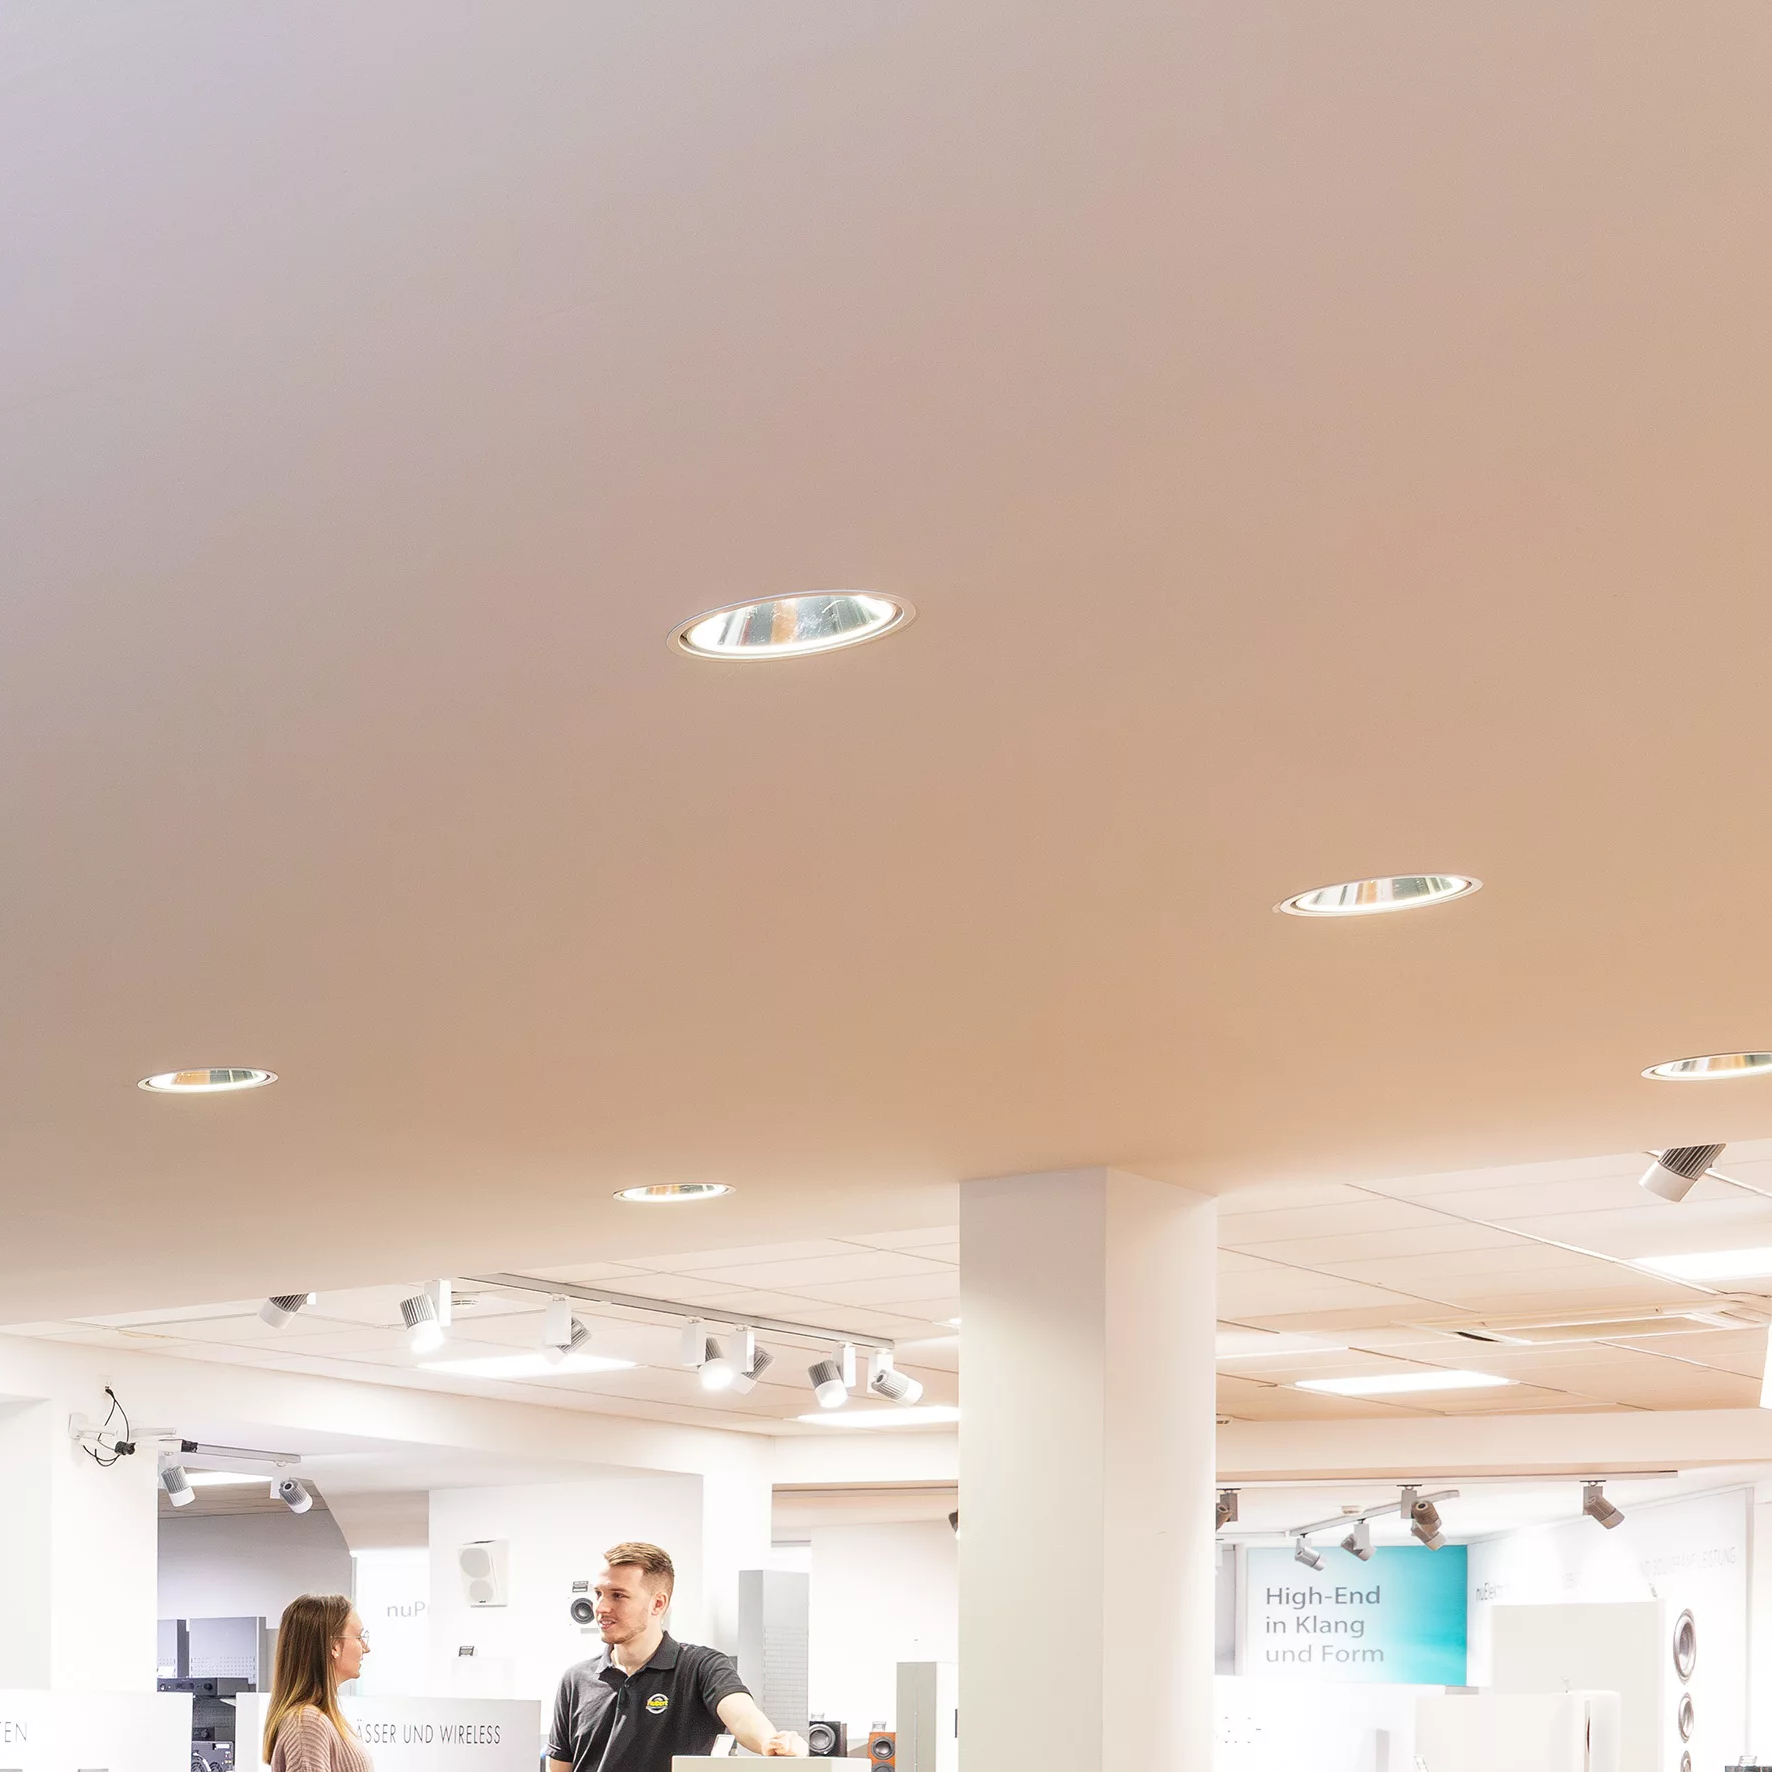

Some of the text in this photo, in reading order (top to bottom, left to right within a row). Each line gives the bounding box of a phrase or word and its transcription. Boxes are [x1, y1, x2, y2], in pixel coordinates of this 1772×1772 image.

[387, 1601, 429, 1617] nuP
[1266, 1585, 1380, 1610] High-End
[1266, 1615, 1365, 1638] in Klang
[1266, 1644, 1384, 1662] und Form
[357, 1719, 501, 1744] ÄSSER UND WIRELESS
